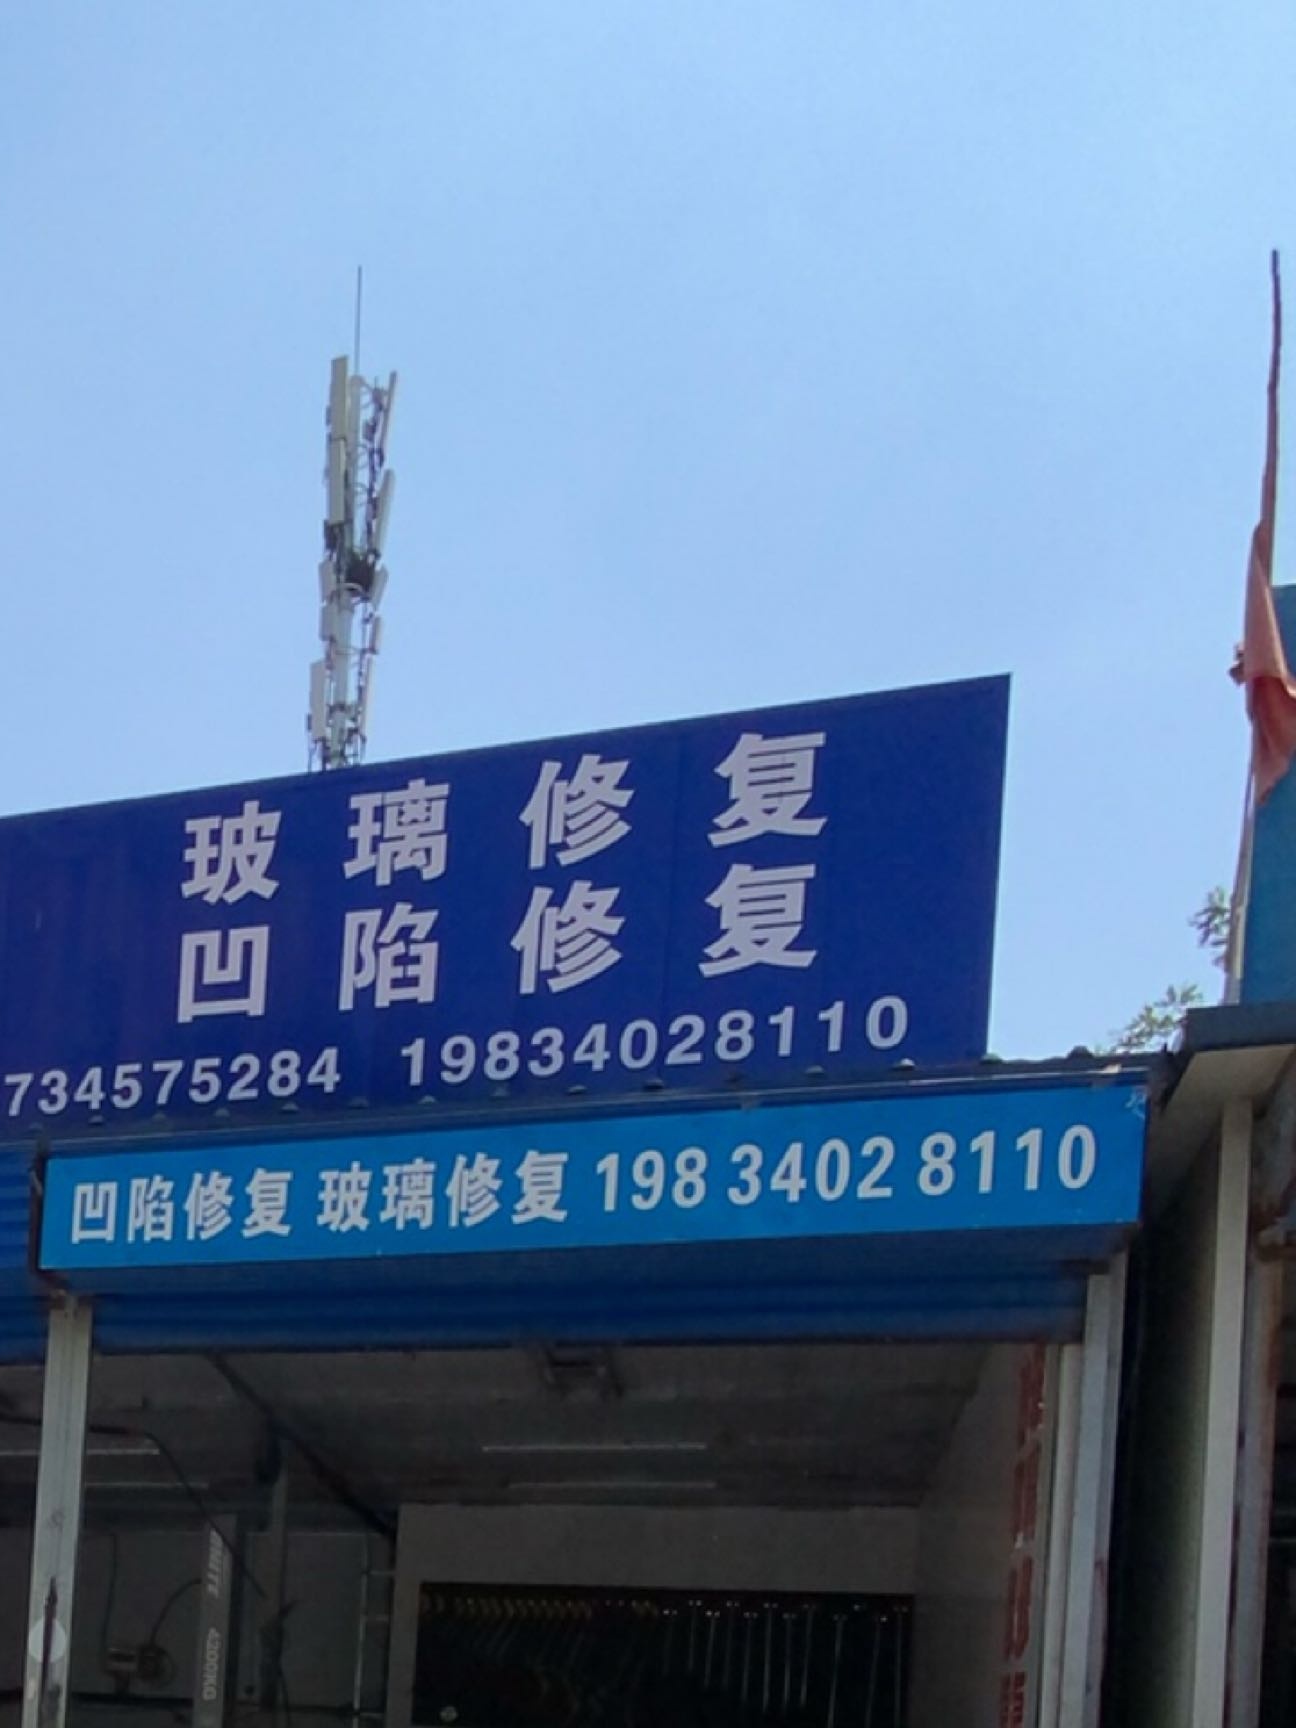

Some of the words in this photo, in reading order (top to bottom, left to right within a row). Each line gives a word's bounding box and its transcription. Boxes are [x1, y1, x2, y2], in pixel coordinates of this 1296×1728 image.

[181, 733, 826, 903] 玻璃修复
[178, 864, 816, 1023] 凹陷修复
[402, 997, 906, 1083] 19834028110
[73, 1170, 291, 1241] 凹陷修复
[318, 1151, 567, 1231] 玻璃修复
[598, 1149, 706, 1210] 198
[729, 1137, 894, 1204] 3402
[919, 1126, 1095, 1195] 8110
